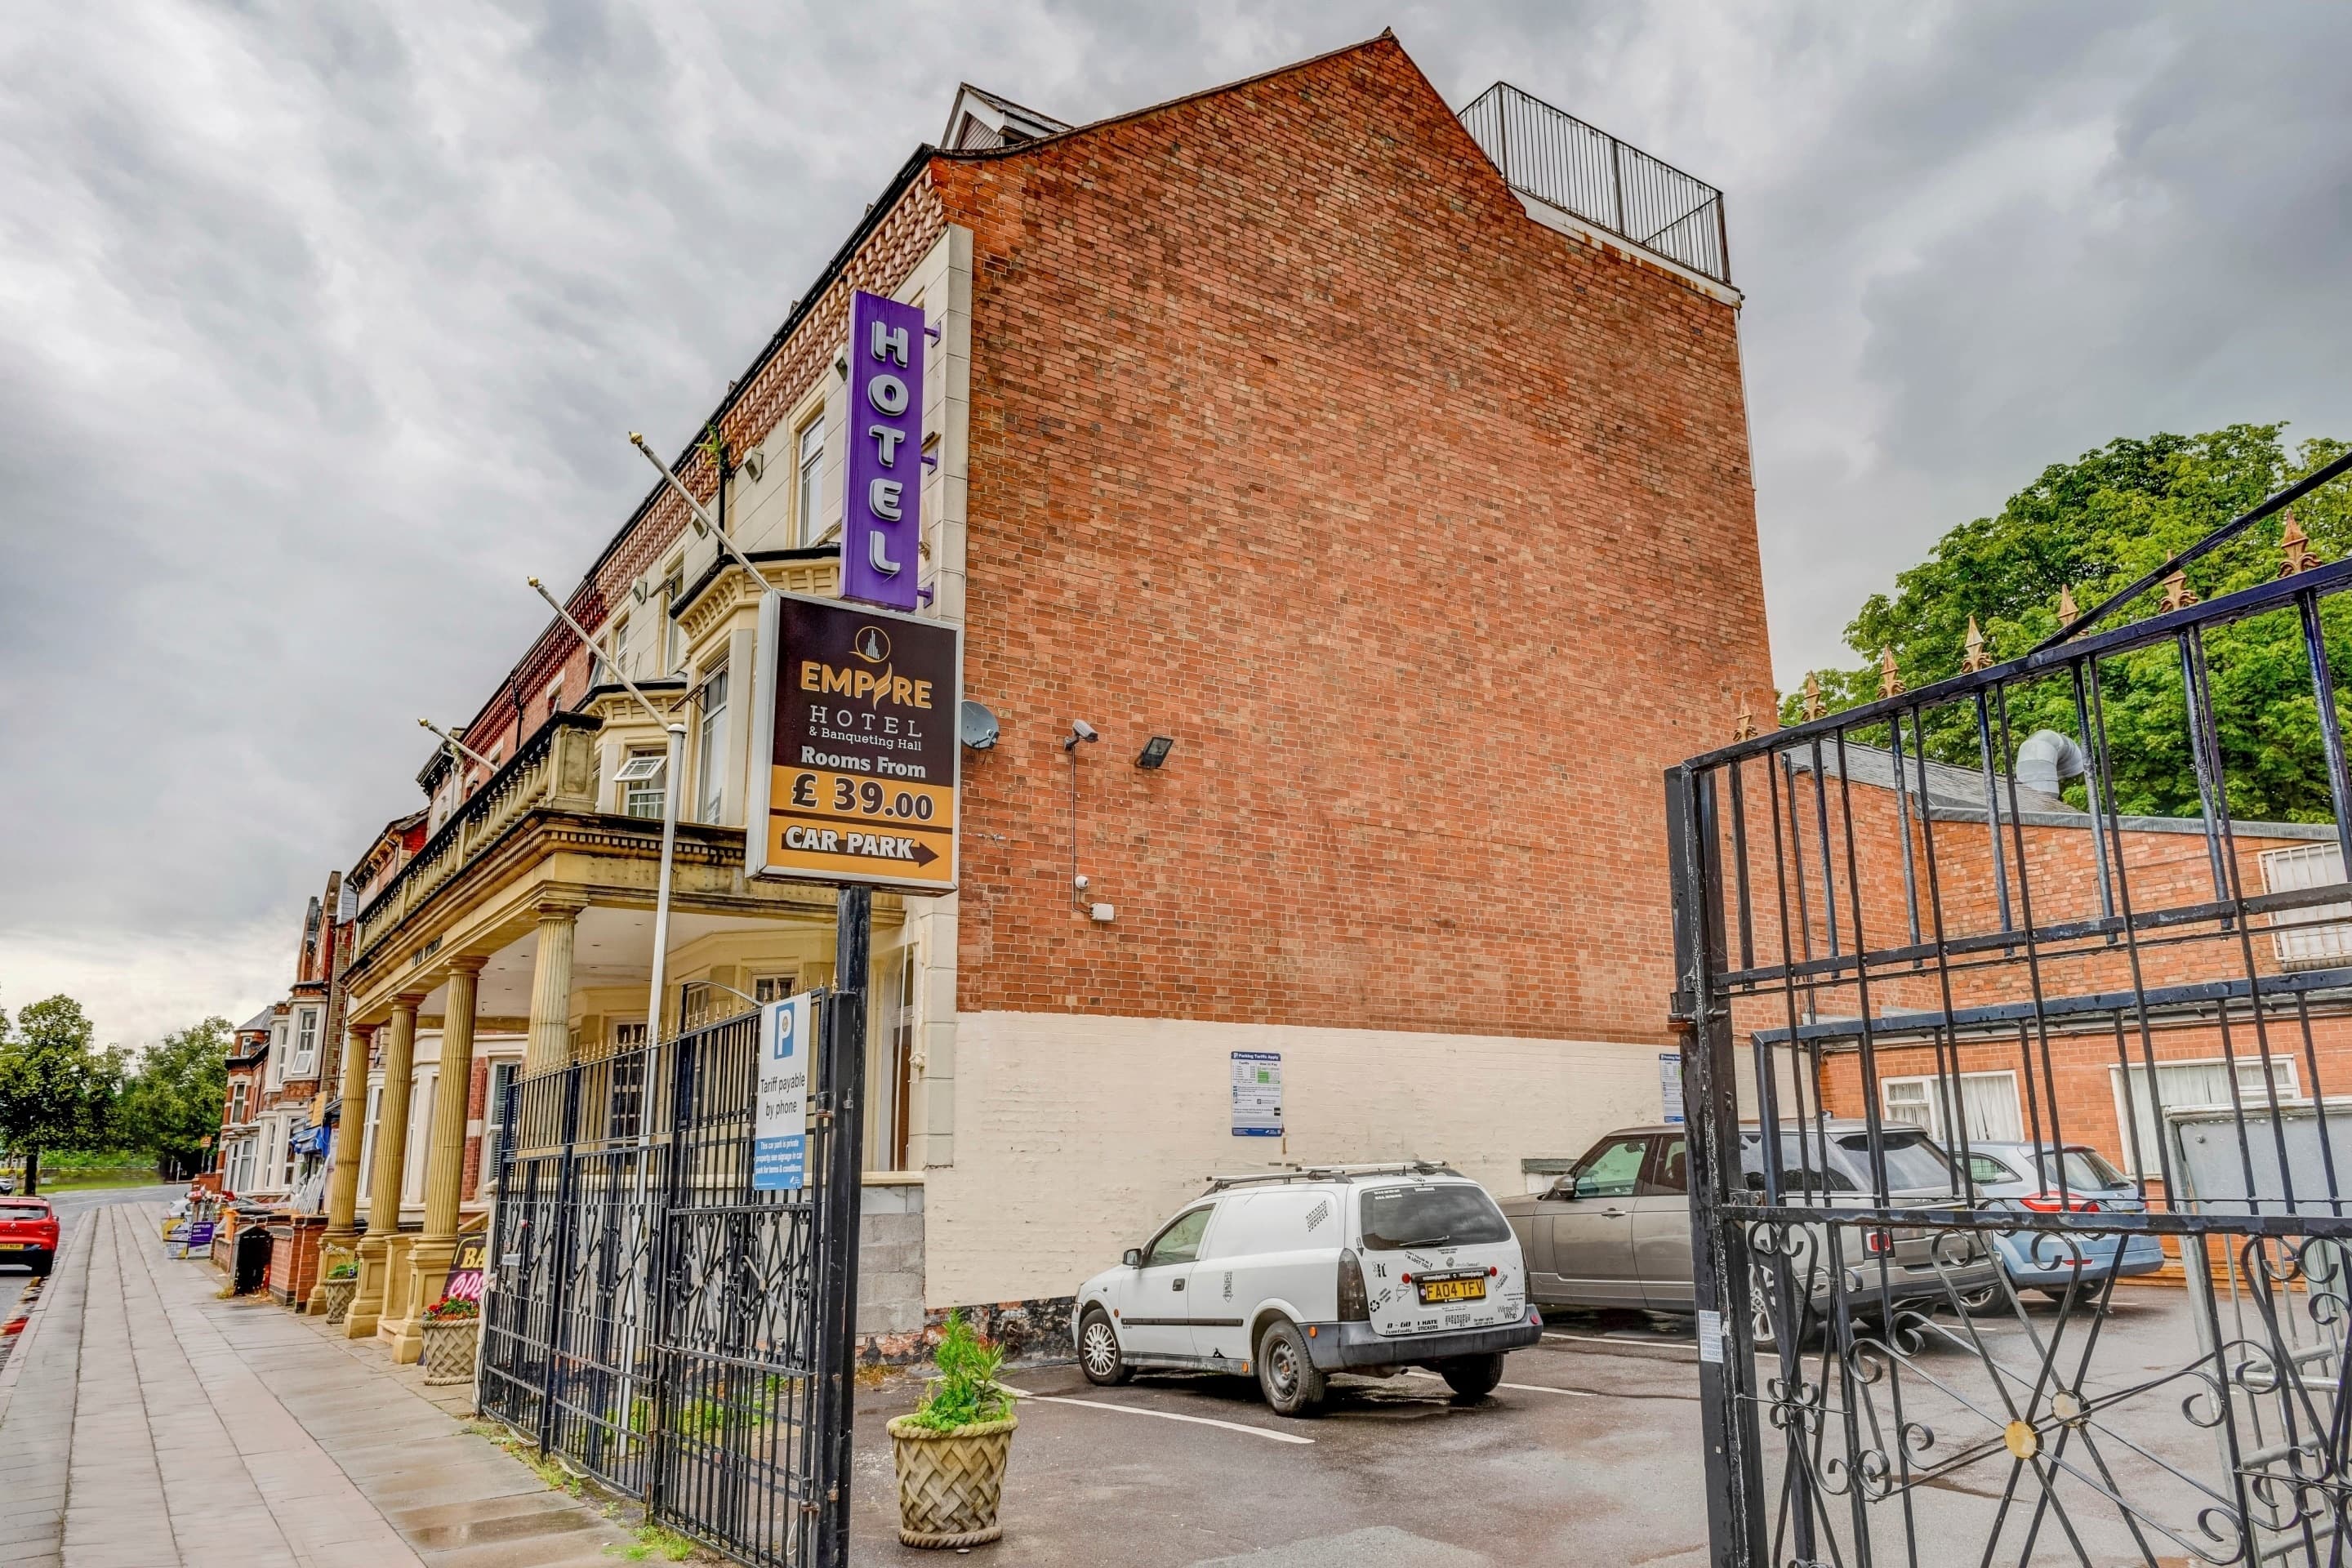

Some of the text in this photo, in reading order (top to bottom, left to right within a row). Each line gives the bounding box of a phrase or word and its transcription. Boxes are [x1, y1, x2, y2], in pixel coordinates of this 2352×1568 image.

[867, 320, 909, 575] HOTEL
[800, 661, 933, 710] EMPIRE
[809, 705, 922, 737] HOTEL
[808, 726, 922, 751] & Banqueting Hall
[800, 745, 927, 778] Rooms From
[791, 773, 934, 821] £ 39.00
[785, 826, 915, 861] CAR PARK
[777, 1009, 792, 1056] P
[760, 1071, 805, 1095] Tariff payable
[765, 1099, 797, 1120] by phone
[460, 1247, 487, 1268] BA
[448, 1272, 483, 1300] OPE
[1426, 1282, 1457, 1298] FA04
[1460, 1280, 1482, 1295] TFV
